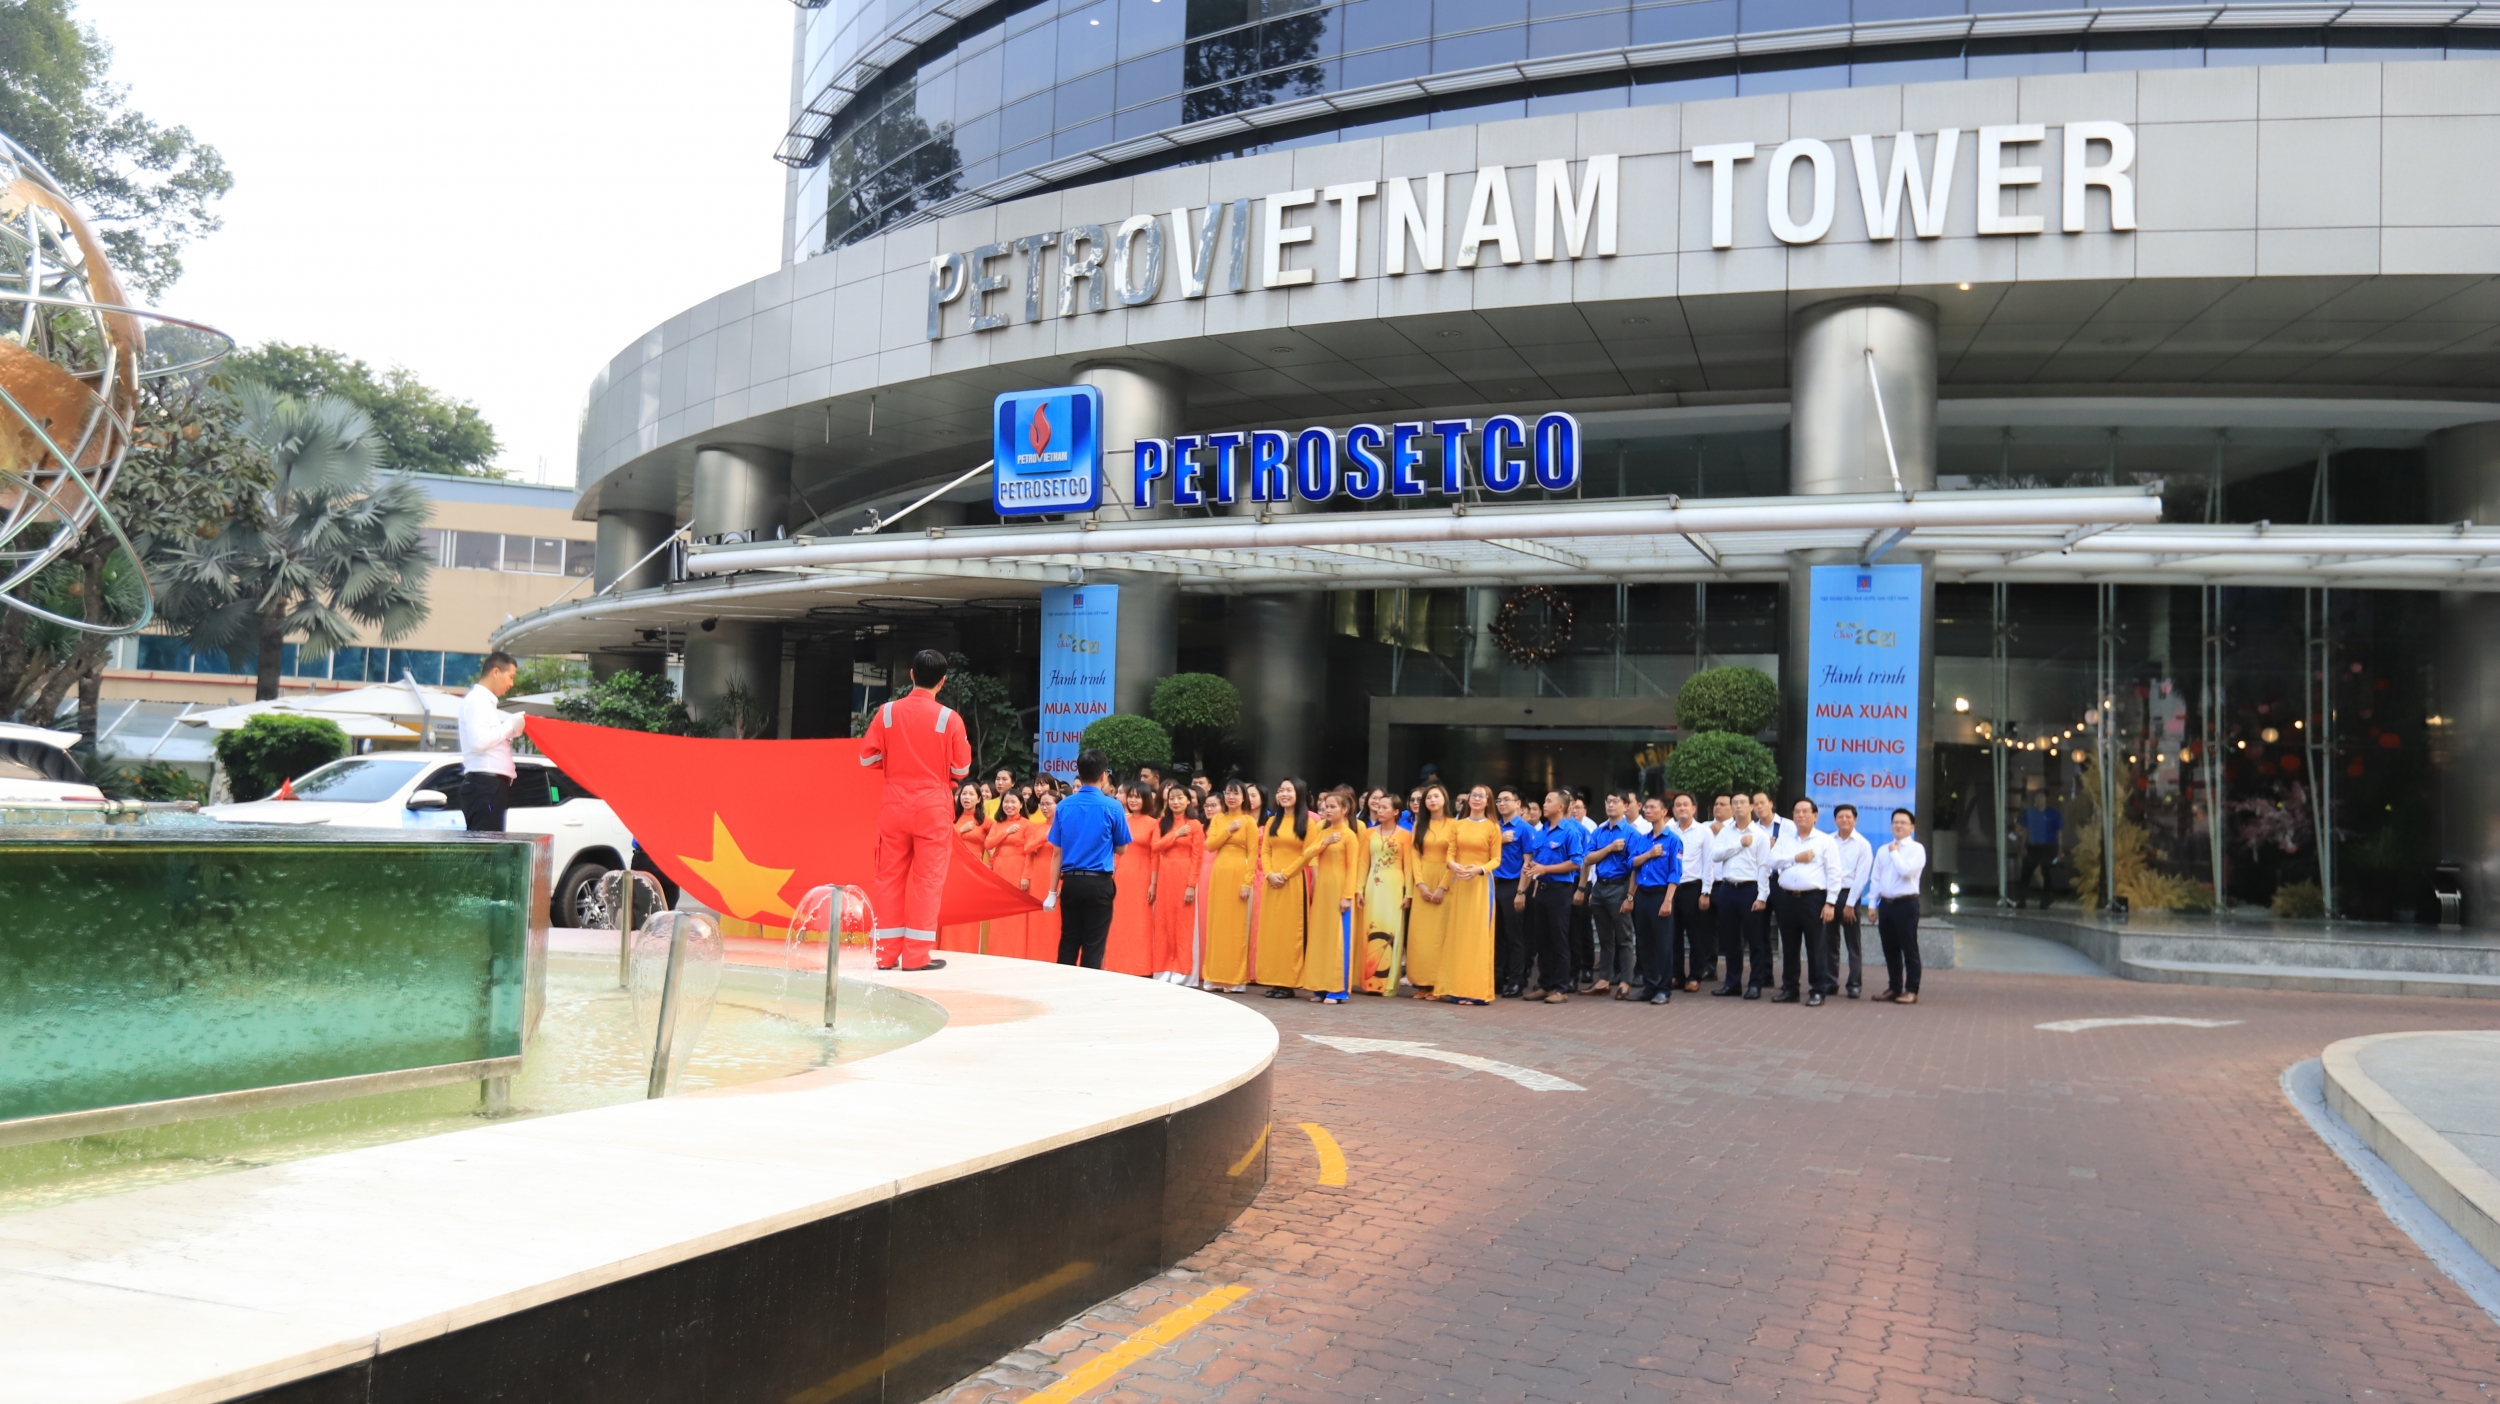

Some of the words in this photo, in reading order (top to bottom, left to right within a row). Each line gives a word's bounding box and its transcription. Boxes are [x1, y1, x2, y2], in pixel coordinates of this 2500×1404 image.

[926, 153, 1620, 342] PETROVIETNAM
[1691, 120, 2137, 250] TOWER
[1017, 451, 1068, 464] PETROVIETNAM
[1134, 411, 1582, 509] PETROSETCO
[1000, 477, 1088, 500] PETROSETCO
[1046, 669, 1077, 689] Hành
[1080, 668, 1107, 685] trình
[1819, 664, 1863, 687] Hành
[1867, 664, 1907, 684] trình
[1044, 700, 1071, 715] MÙA
[1073, 700, 1107, 715] XUÂN
[1815, 701, 1854, 719] MÙA
[1859, 701, 1907, 719] XUÂN
[1045, 729, 1060, 743] TỪ
[1816, 735, 1837, 752] TỪ
[1841, 736, 1905, 754] NHỮNG
[1043, 756, 1078, 773] GIẾNG
[1813, 768, 1866, 787] GIẾNG
[1871, 769, 1907, 789] DẦU
